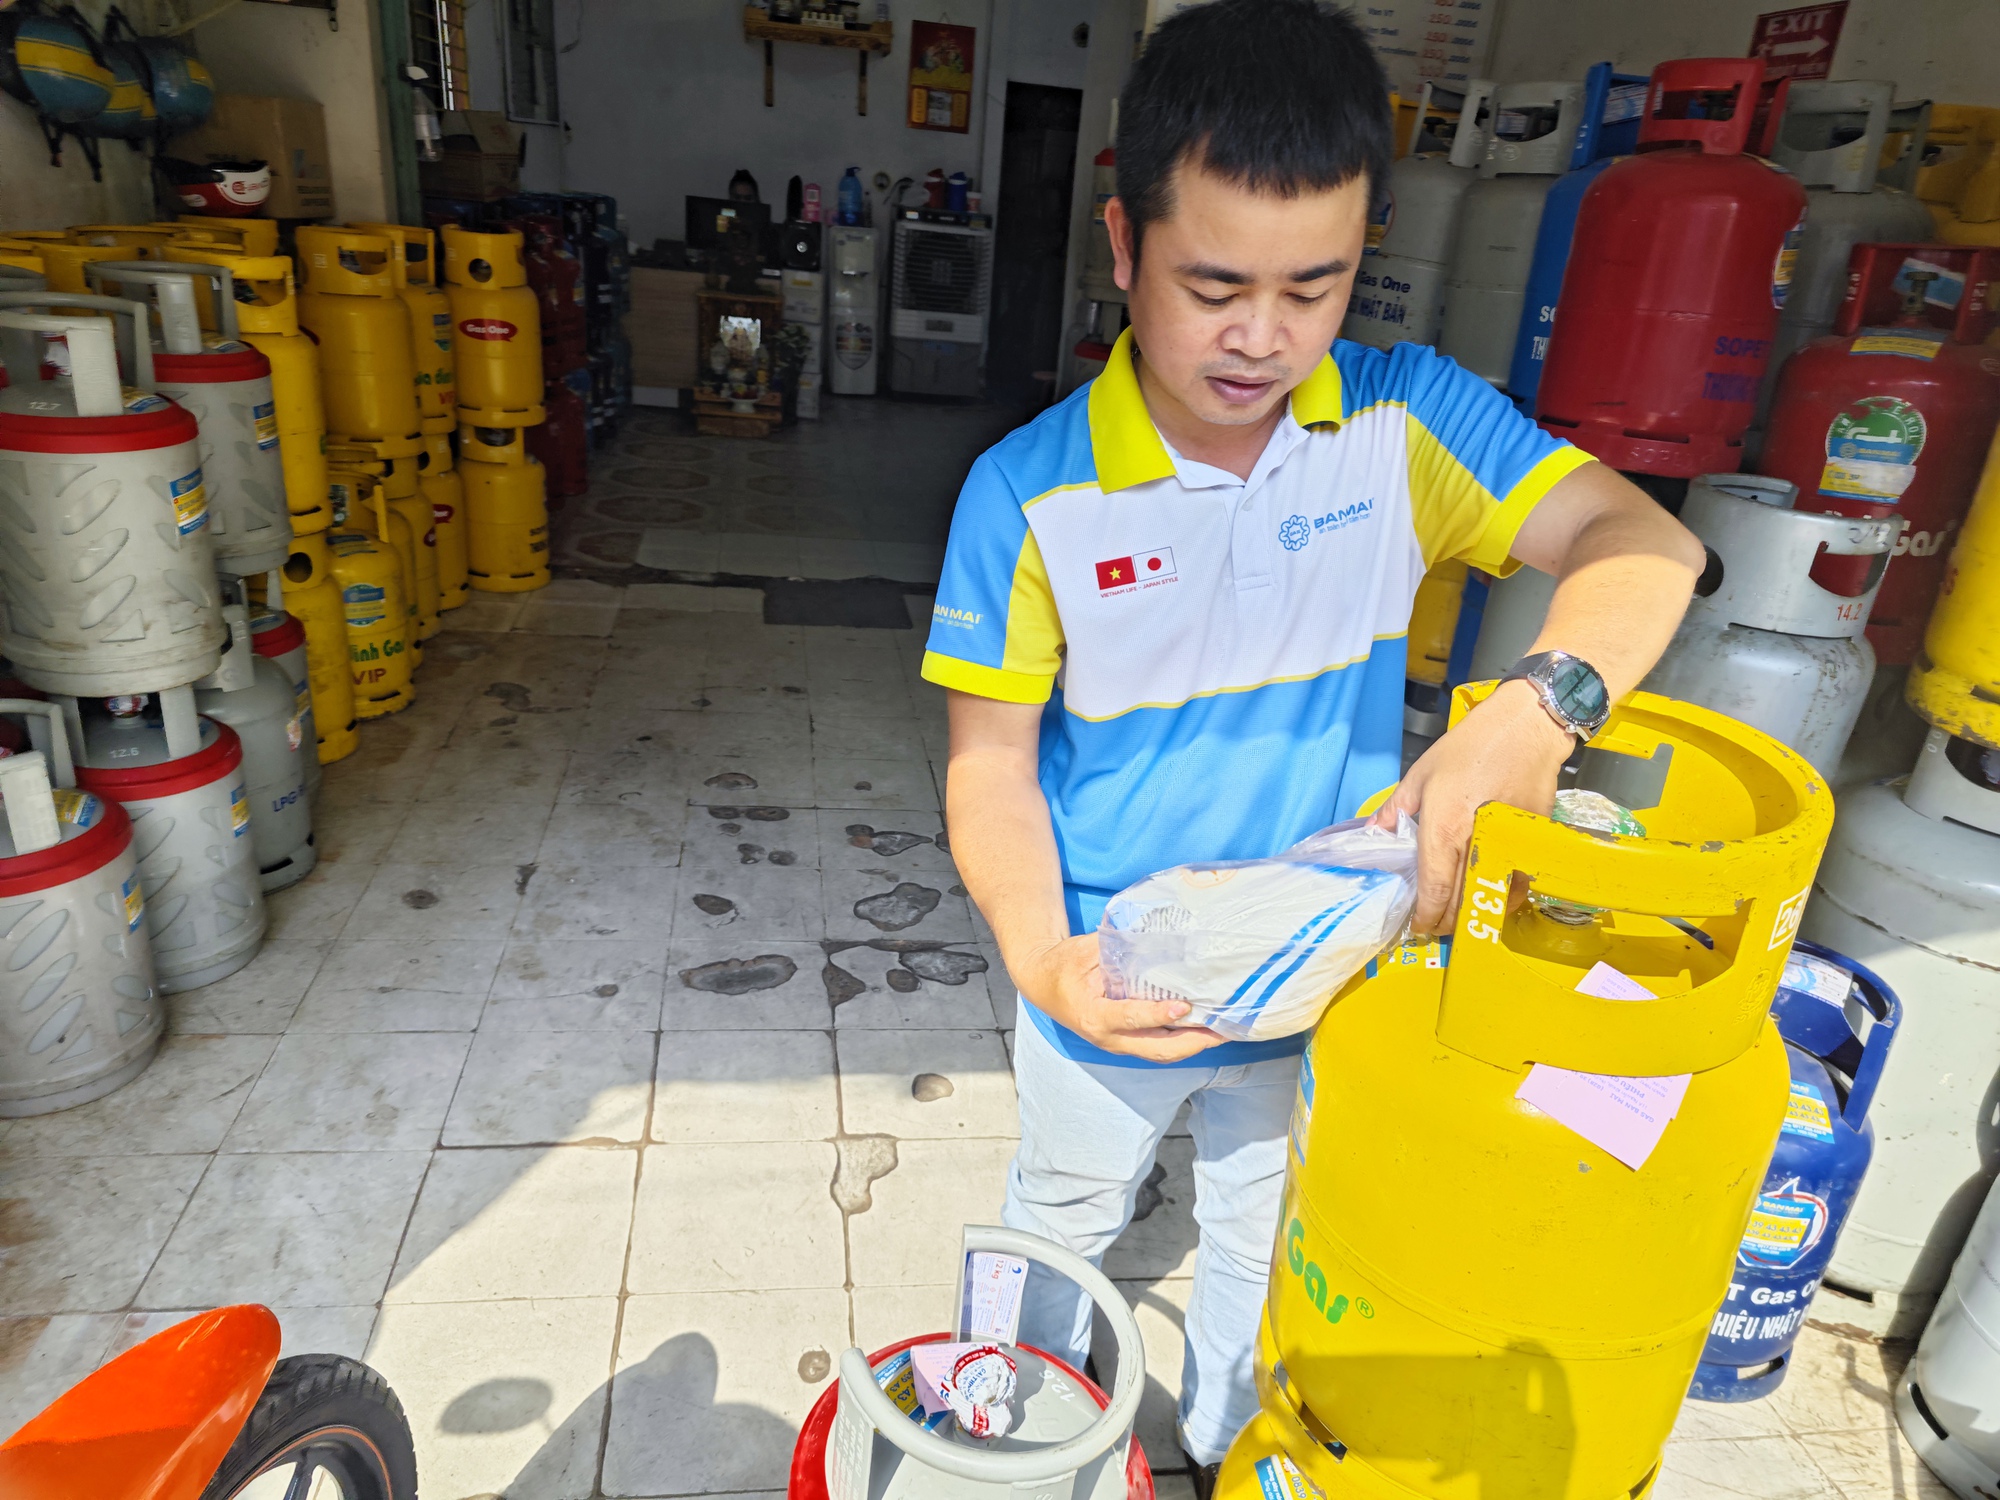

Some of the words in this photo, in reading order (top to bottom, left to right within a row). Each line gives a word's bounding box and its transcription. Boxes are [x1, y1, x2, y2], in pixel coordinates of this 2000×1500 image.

[1765, 9, 1832, 36] EXIT
[1380, 274, 1411, 294] One
[28, 400, 62, 412] 12.7
[1101, 588, 1125, 598] VIETNAM
[1126, 585, 1138, 593] LIFE
[1143, 580, 1161, 589] JAPAN
[1162, 576, 1178, 585] STYLE
[1837, 604, 1862, 621] 14.2
[353, 667, 387, 685] VIP
[109, 746, 140, 758] 12.6
[1466, 876, 1507, 945] 13.5
[1620, 1077, 1646, 1099] PHIẾU
[1609, 1092, 1625, 1105] MAI
[1624, 1101, 1640, 1114] BAN
[1639, 1111, 1655, 1123] GAS
[1750, 1286, 1798, 1306] Gas
[1710, 1309, 1761, 1344] HIỆU
[1758, 1307, 1802, 1341] NHẬT
[1038, 1368, 1076, 1402] 12.6
